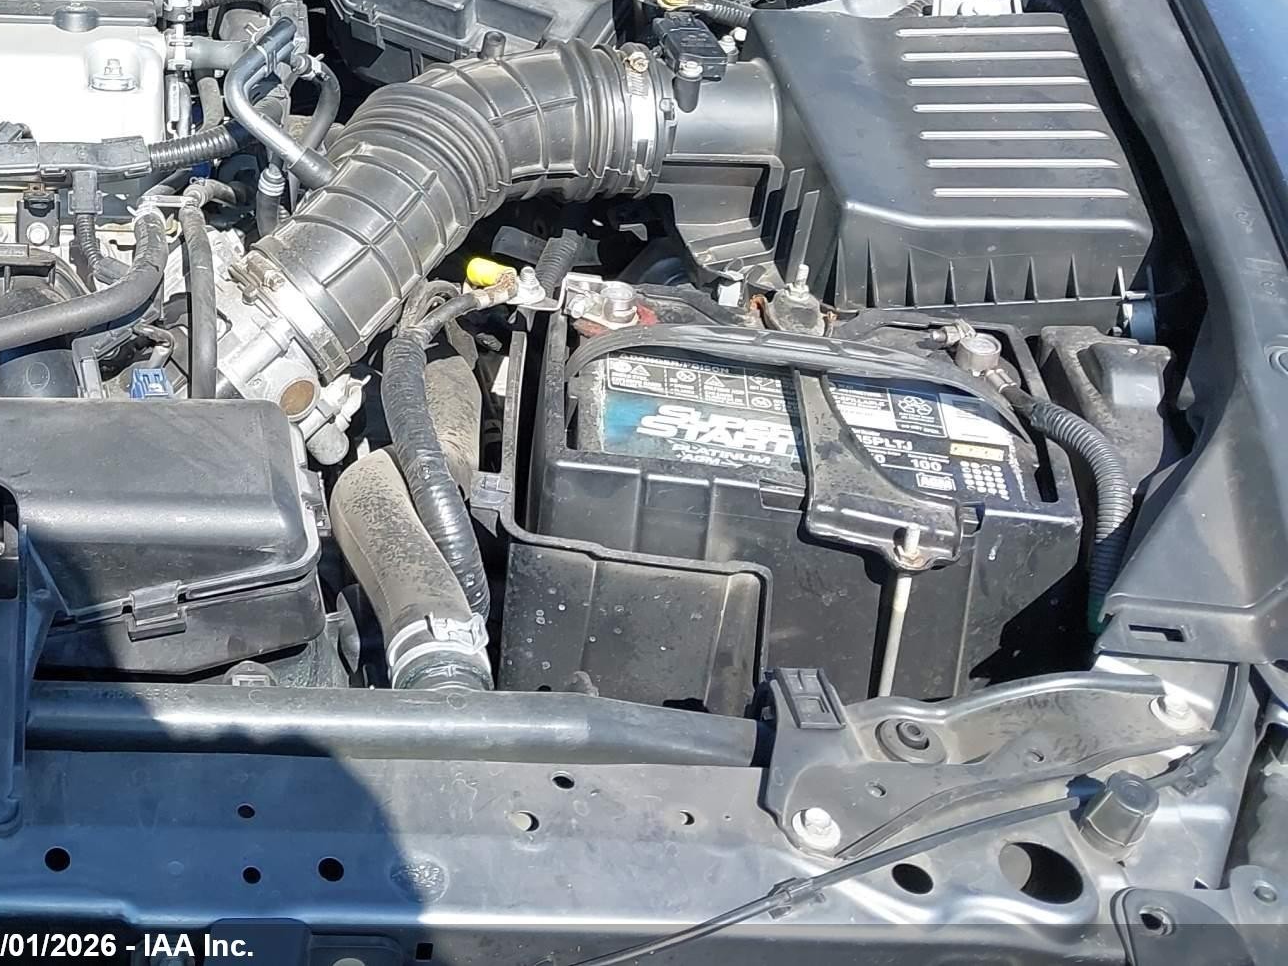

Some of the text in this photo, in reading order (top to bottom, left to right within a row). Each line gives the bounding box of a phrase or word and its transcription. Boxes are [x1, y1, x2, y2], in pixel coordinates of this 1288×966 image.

[636, 415, 799, 458] START
[657, 404, 795, 440] SUPER
[672, 443, 772, 465] PLATINUM
[910, 458, 943, 472] 100
